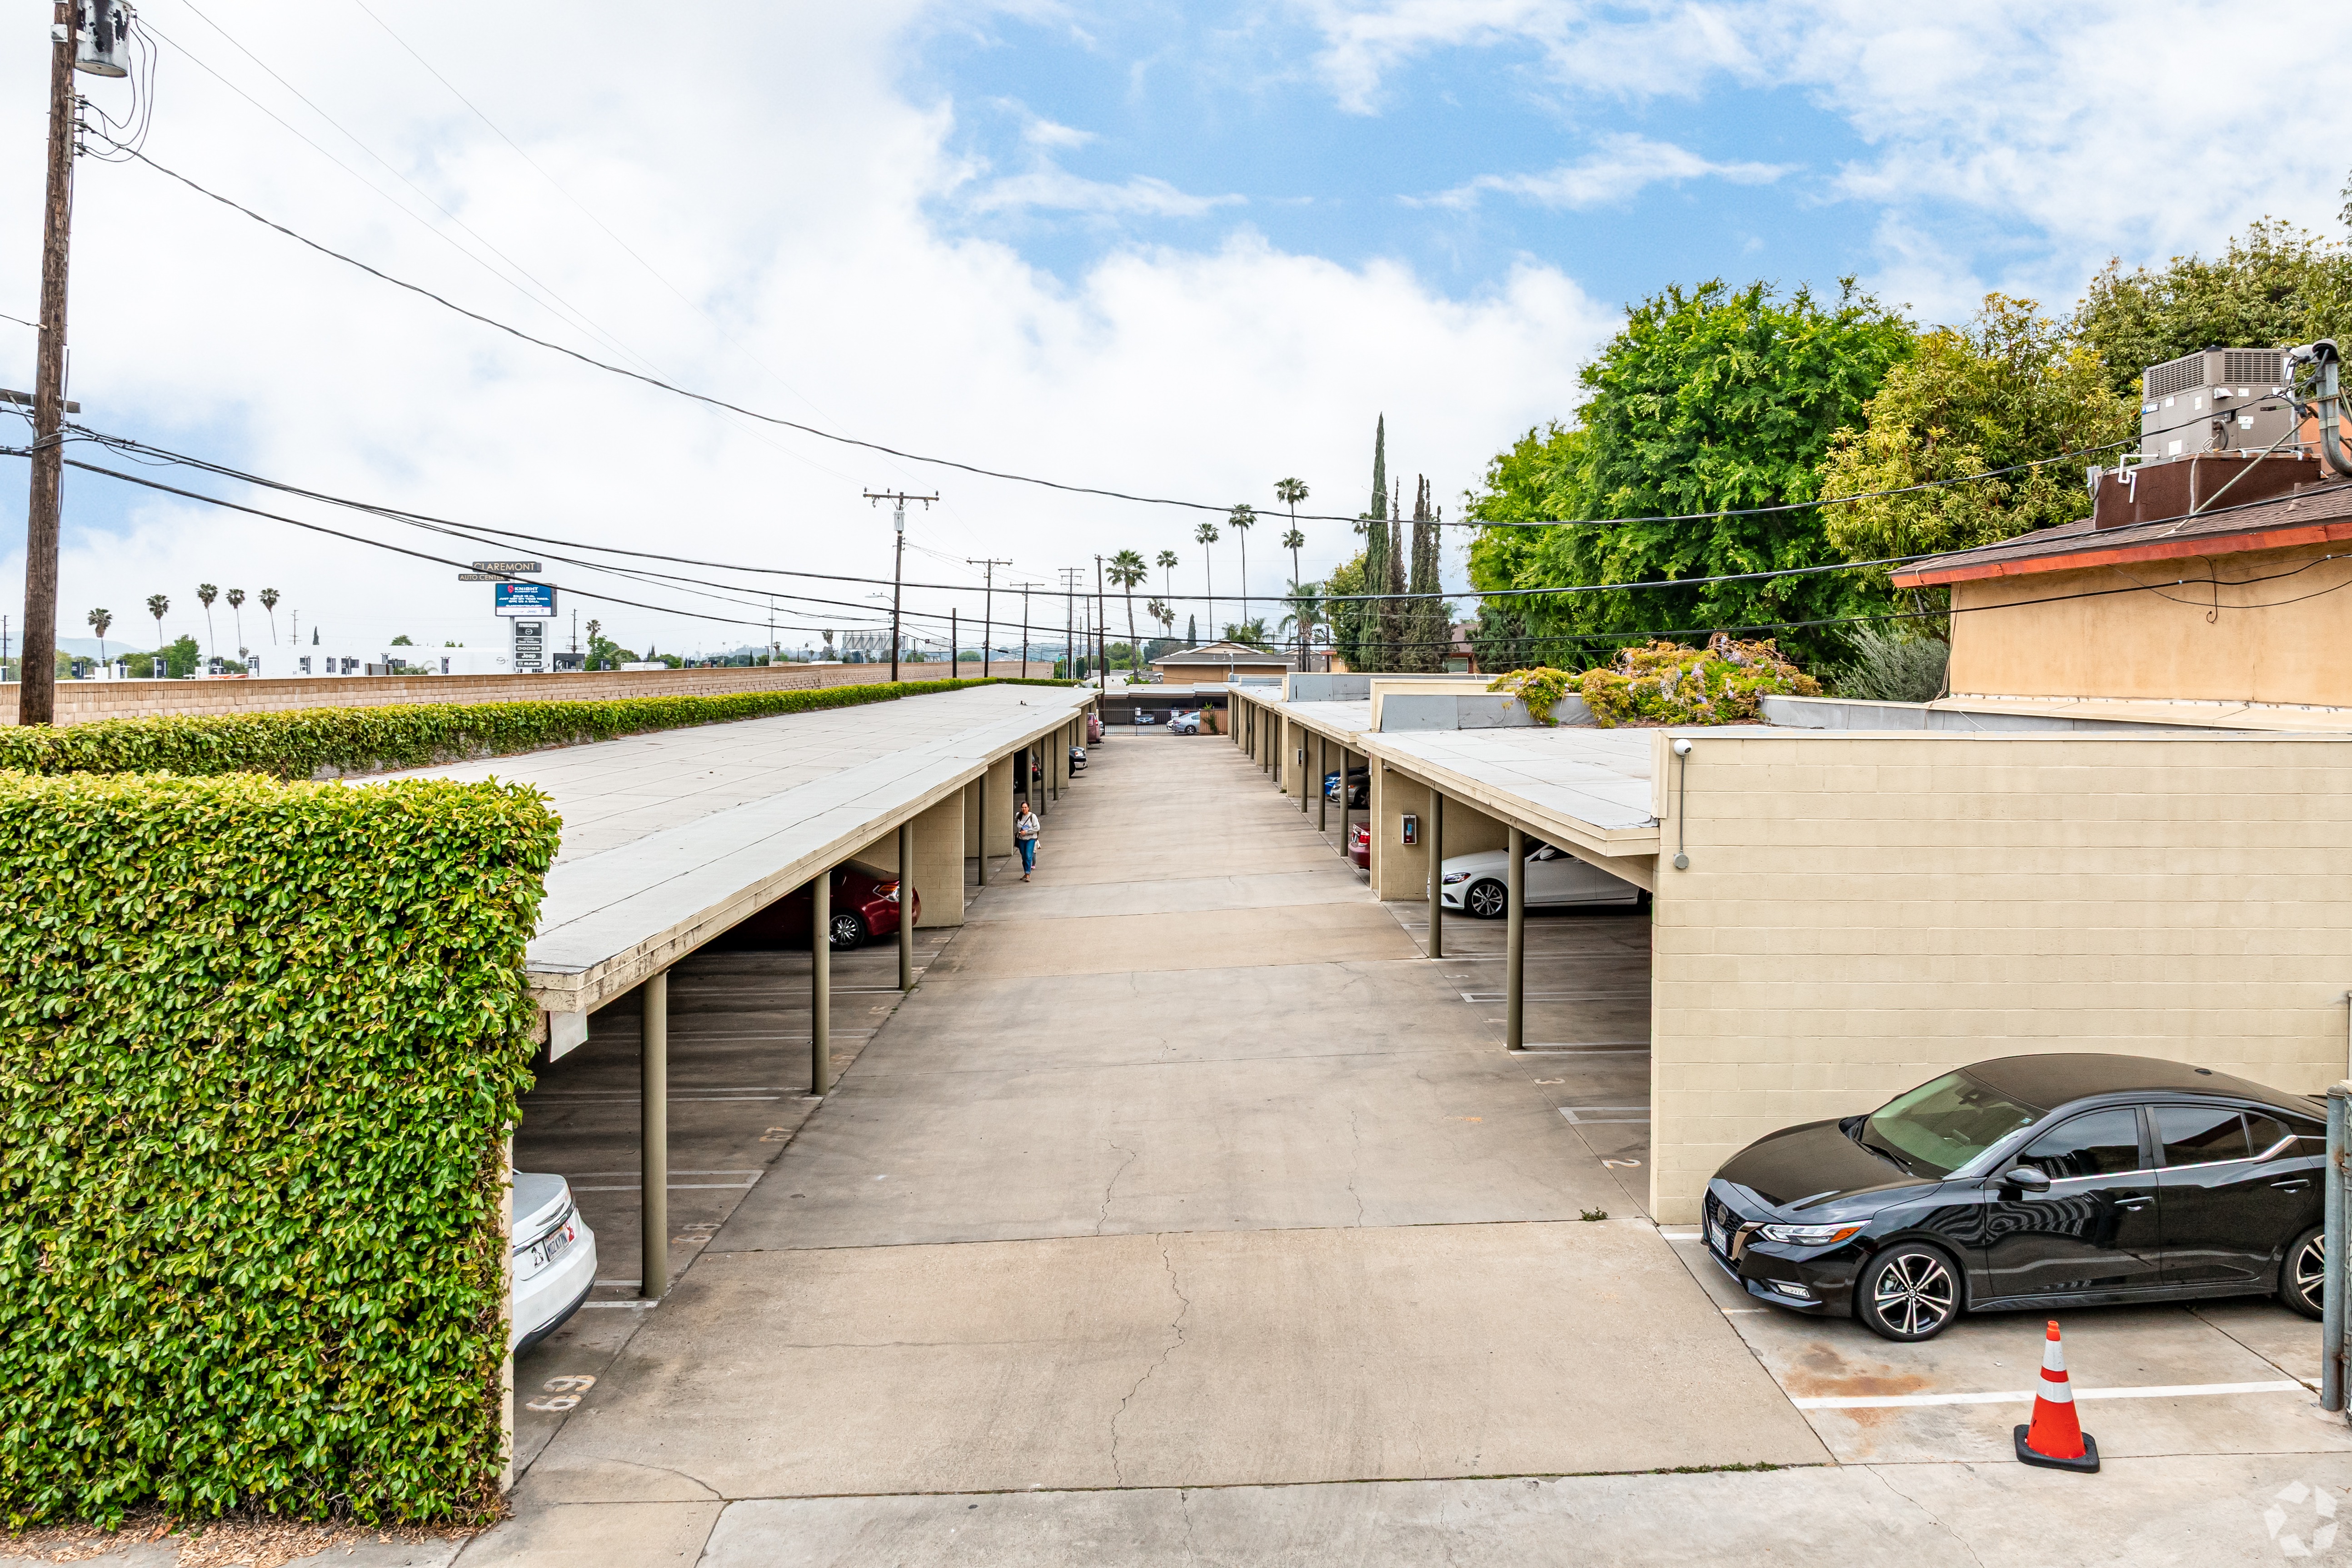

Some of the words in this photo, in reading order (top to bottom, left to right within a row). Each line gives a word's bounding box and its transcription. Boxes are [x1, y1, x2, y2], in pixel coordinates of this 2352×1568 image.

[474, 563, 535, 571] CLAREMONT
[1601, 1158, 1642, 1169] 2
[525, 1375, 596, 1412] 69
